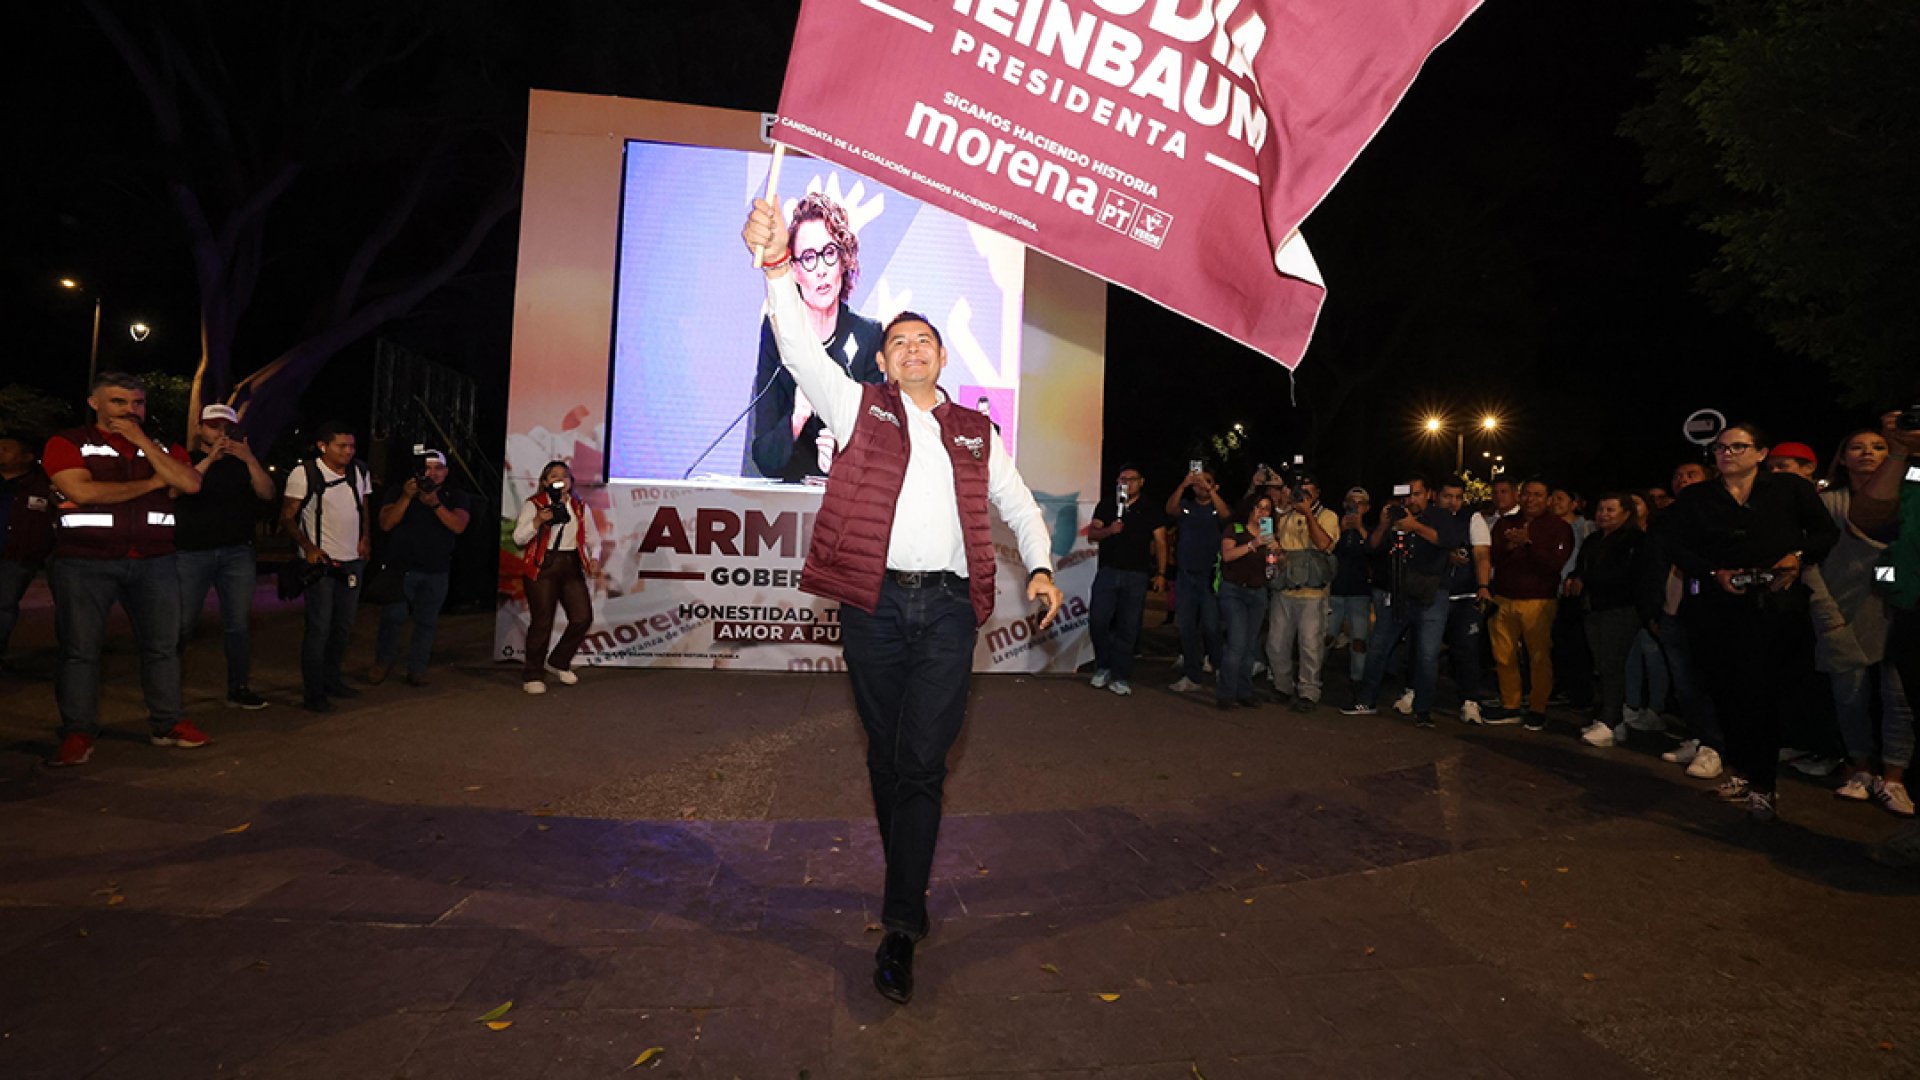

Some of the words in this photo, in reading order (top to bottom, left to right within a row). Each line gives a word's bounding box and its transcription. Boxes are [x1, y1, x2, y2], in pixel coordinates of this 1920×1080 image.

[951, 29, 1187, 159] PRESIDENTA
[781, 116, 833, 143] CANDIDATA
[834, 138, 848, 150] DE
[848, 143, 861, 156] LA
[943, 91, 1011, 133] SIGAMOS
[1013, 124, 1090, 168] HACIENDO
[1091, 158, 1158, 199] HISTORIA
[905, 100, 1099, 216] morena
[1101, 203, 1132, 229] PT
[679, 603, 819, 626] HONESTIDAD,
[718, 625, 784, 641] AMOR
[789, 626, 806, 641] A
